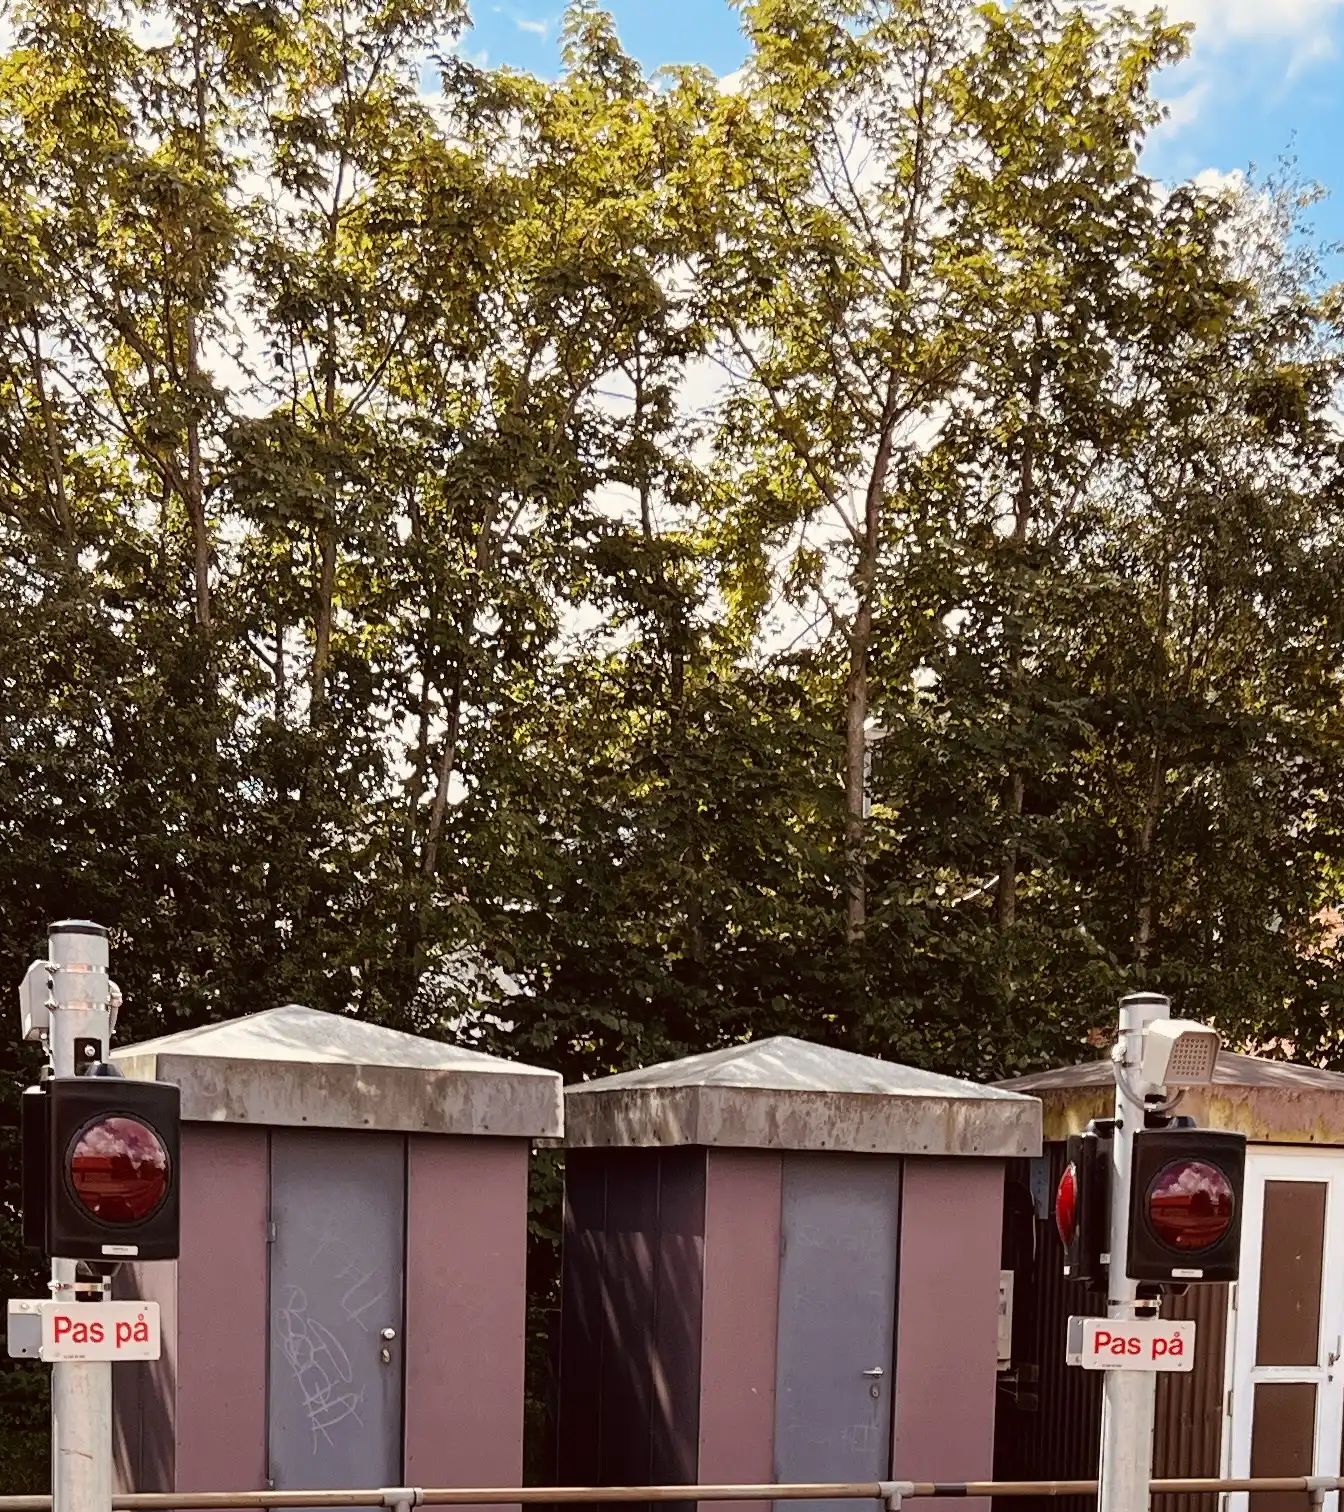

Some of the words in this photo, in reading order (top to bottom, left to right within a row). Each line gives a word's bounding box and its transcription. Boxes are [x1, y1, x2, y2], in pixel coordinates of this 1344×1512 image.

[53, 1315, 105, 1344] Pas
[115, 1313, 149, 1349] på
[1094, 1331, 1142, 1355] Pas
[1151, 1331, 1184, 1360] på
